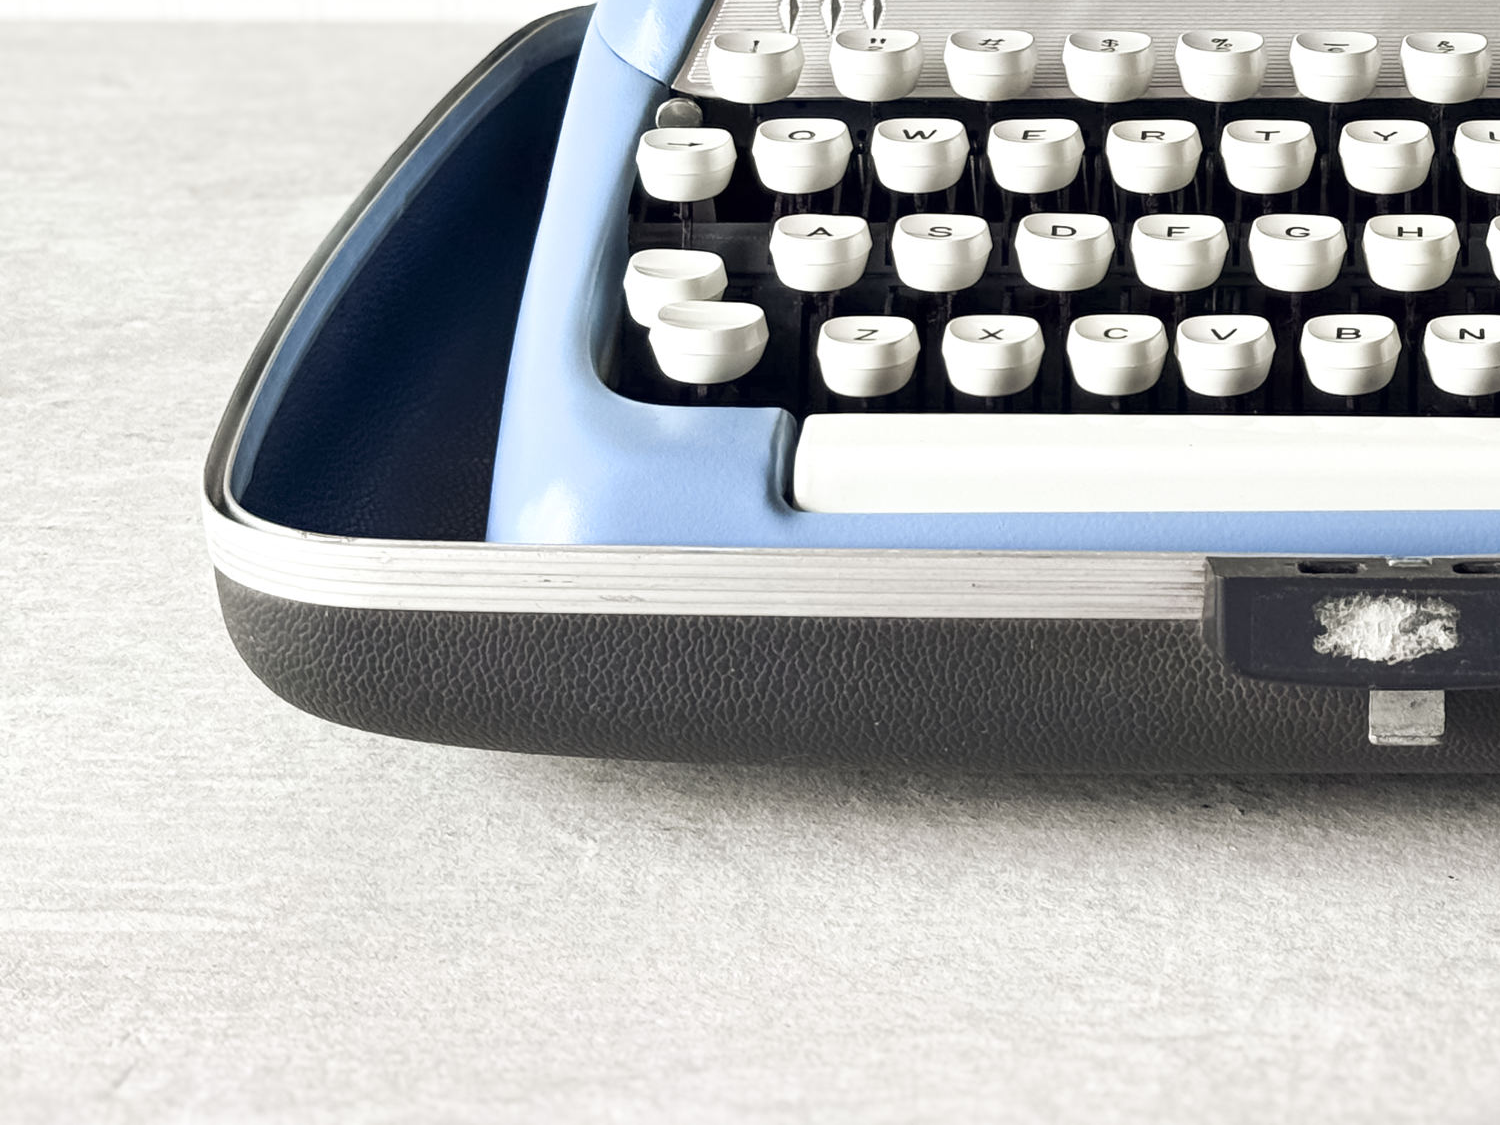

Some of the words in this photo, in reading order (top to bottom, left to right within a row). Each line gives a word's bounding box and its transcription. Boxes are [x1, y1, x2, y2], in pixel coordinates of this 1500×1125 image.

[978, 38, 1005, 47] #
[1211, 38, 1233, 48] %
[902, 129, 938, 140] W
[1021, 129, 1047, 140] E
[1140, 130, 1166, 141] R
[1254, 130, 1281, 141] T
[1373, 131, 1398, 142] Y
[807, 226, 834, 237] A
[928, 226, 953, 238] S
[1050, 225, 1077, 237] D
[1166, 226, 1190, 238] F
[1285, 226, 1311, 238] G
[1397, 226, 1423, 237] H
[853, 329, 880, 341] Z
[978, 329, 1005, 340] X
[1103, 327, 1129, 340] C
[1210, 328, 1238, 340] V
[1335, 327, 1363, 340] B
[1459, 328, 1485, 340] N
